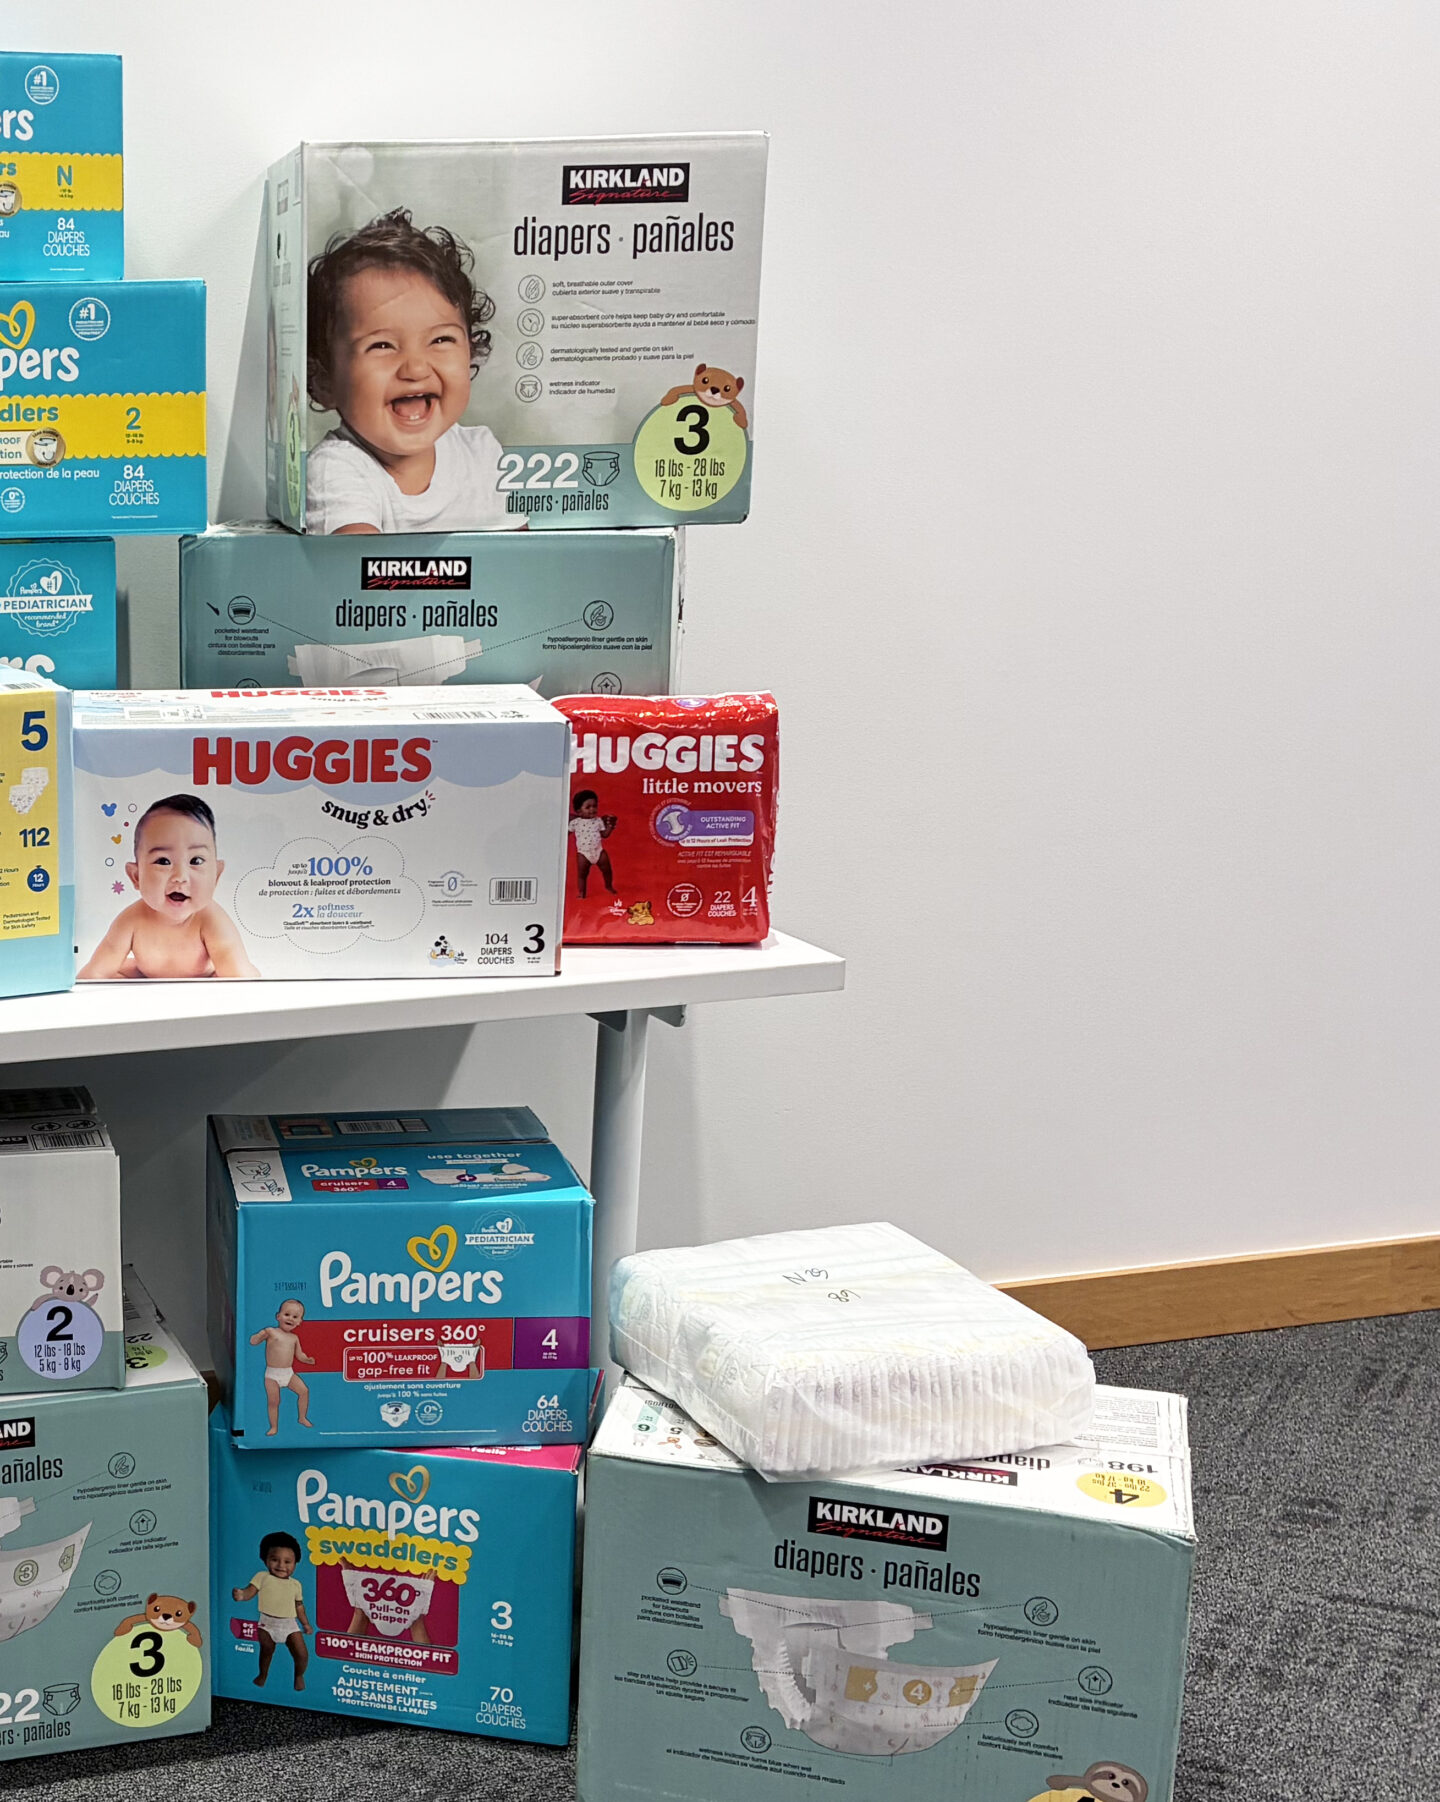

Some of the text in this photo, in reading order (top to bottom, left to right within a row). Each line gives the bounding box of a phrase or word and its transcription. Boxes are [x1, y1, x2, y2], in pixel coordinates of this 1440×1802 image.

[57, 165, 72, 186] N
[569, 168, 685, 189] KIRKLAND
[57, 218, 75, 230] 84
[48, 231, 85, 243] DIAPERS
[514, 213, 734, 261] diapers pañales
[43, 245, 90, 256] COUCHES
[126, 408, 141, 430] 2
[674, 404, 710, 454] 3
[497, 453, 578, 489] 222
[655, 458, 725, 477] 16 lbs 28 lbs
[507, 489, 609, 516] diapers pañales
[367, 560, 467, 578] KIRKLAND
[4, 599, 87, 610] PEDIATRICIAN
[336, 599, 498, 630] diapers pañales
[21, 710, 48, 752] 5
[193, 736, 432, 785] HUGGIES
[570, 733, 764, 774] HUGGIES
[643, 778, 762, 794] little movers
[321, 798, 370, 830] snug
[373, 809, 388, 826] &
[19, 827, 50, 847] 112
[308, 856, 373, 876] 100%
[268, 879, 302, 887] blowout
[311, 879, 348, 887] leakproof
[349, 879, 390, 887] protection
[714, 891, 731, 902] 22
[742, 886, 757, 907] 4
[292, 903, 314, 918] 2x
[317, 903, 354, 911] softness
[484, 933, 508, 945] 104
[523, 923, 545, 954] 3
[478, 956, 514, 965] COUCHES
[481, 947, 512, 956] DIAPERS
[319, 1251, 503, 1312] Pampers
[46, 1306, 74, 1341] 2
[343, 1324, 435, 1343] cruisers
[542, 1329, 559, 1350] 4
[357, 1364, 430, 1378] gap-free fit
[537, 1394, 559, 1408] 64
[527, 1410, 567, 1421] DIAPERS
[522, 1421, 572, 1432] COUCHES
[296, 1469, 481, 1543] Pampers
[816, 1502, 944, 1536] KIRKLAND
[319, 1536, 458, 1571] swaddlers
[775, 1539, 981, 1597] diapers pañales
[370, 1603, 410, 1615] Pull-On
[371, 1612, 408, 1625] Diaper
[491, 1601, 513, 1630] 3
[129, 1631, 166, 1677] 3
[356, 1641, 451, 1663] LEAKPROOF FIT
[338, 1677, 418, 1696] AJUSTEMENT
[489, 1687, 513, 1702] 70
[480, 1702, 522, 1717] DIAPERS
[476, 1713, 526, 1729] COUCHES
